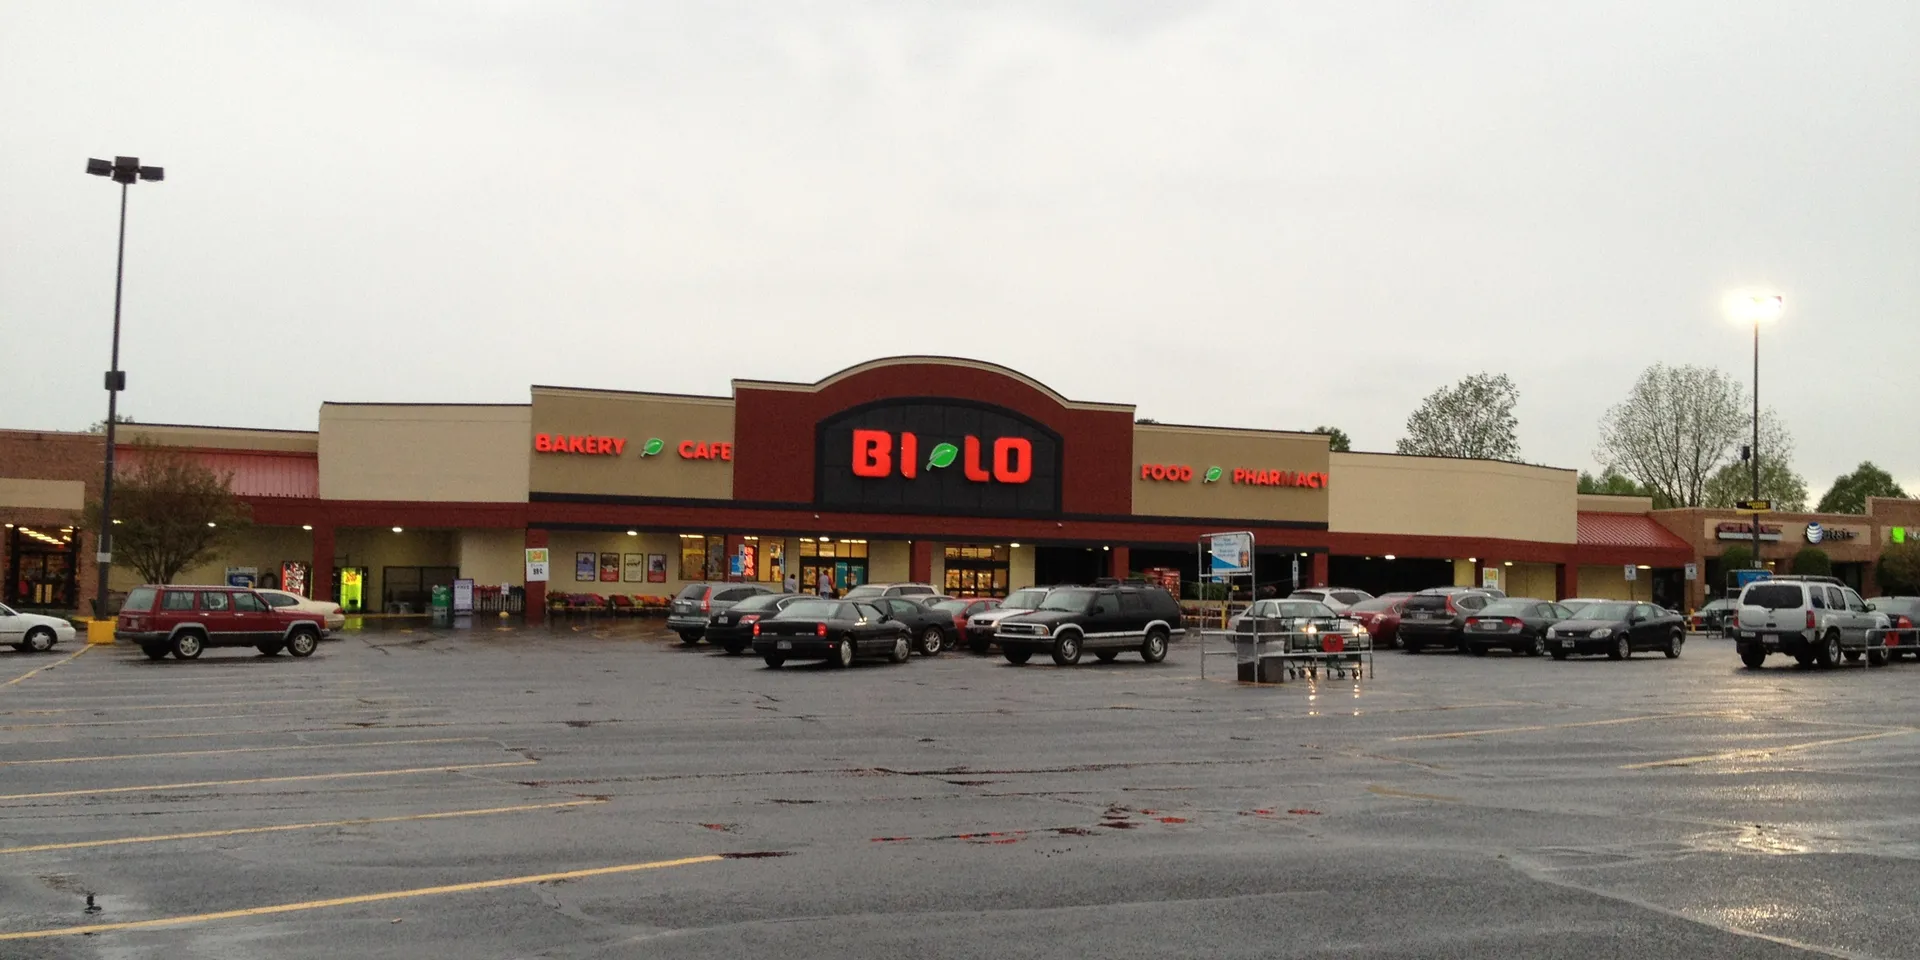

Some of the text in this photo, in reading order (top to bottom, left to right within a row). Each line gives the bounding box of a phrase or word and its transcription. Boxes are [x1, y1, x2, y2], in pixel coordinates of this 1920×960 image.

[534, 433, 733, 461] BAKERY CAFE
[852, 429, 1032, 484] BI LO
[1140, 464, 1330, 489] FOOD PHARMACY
